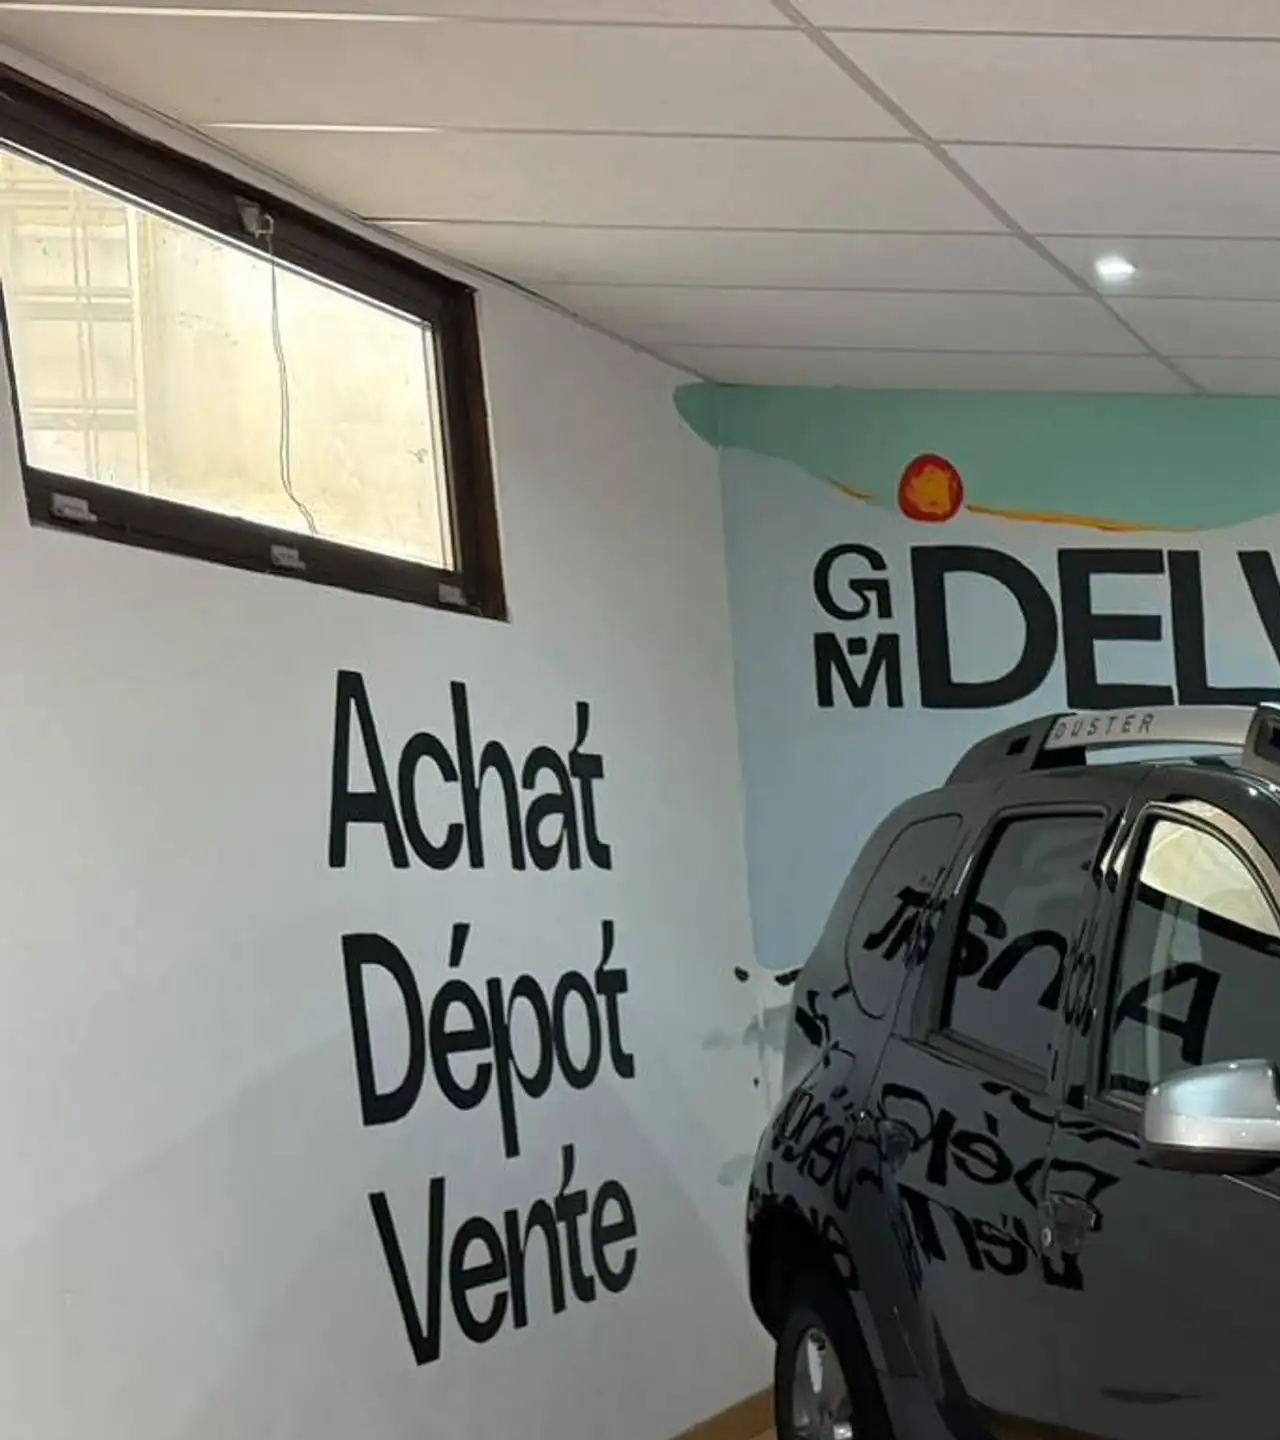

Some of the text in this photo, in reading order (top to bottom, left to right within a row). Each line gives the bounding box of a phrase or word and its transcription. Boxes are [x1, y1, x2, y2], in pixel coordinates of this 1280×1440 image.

[328, 669, 612, 871] Achat
[1053, 713, 1155, 740] DUSTER
[368, 1143, 639, 1366] Vente
